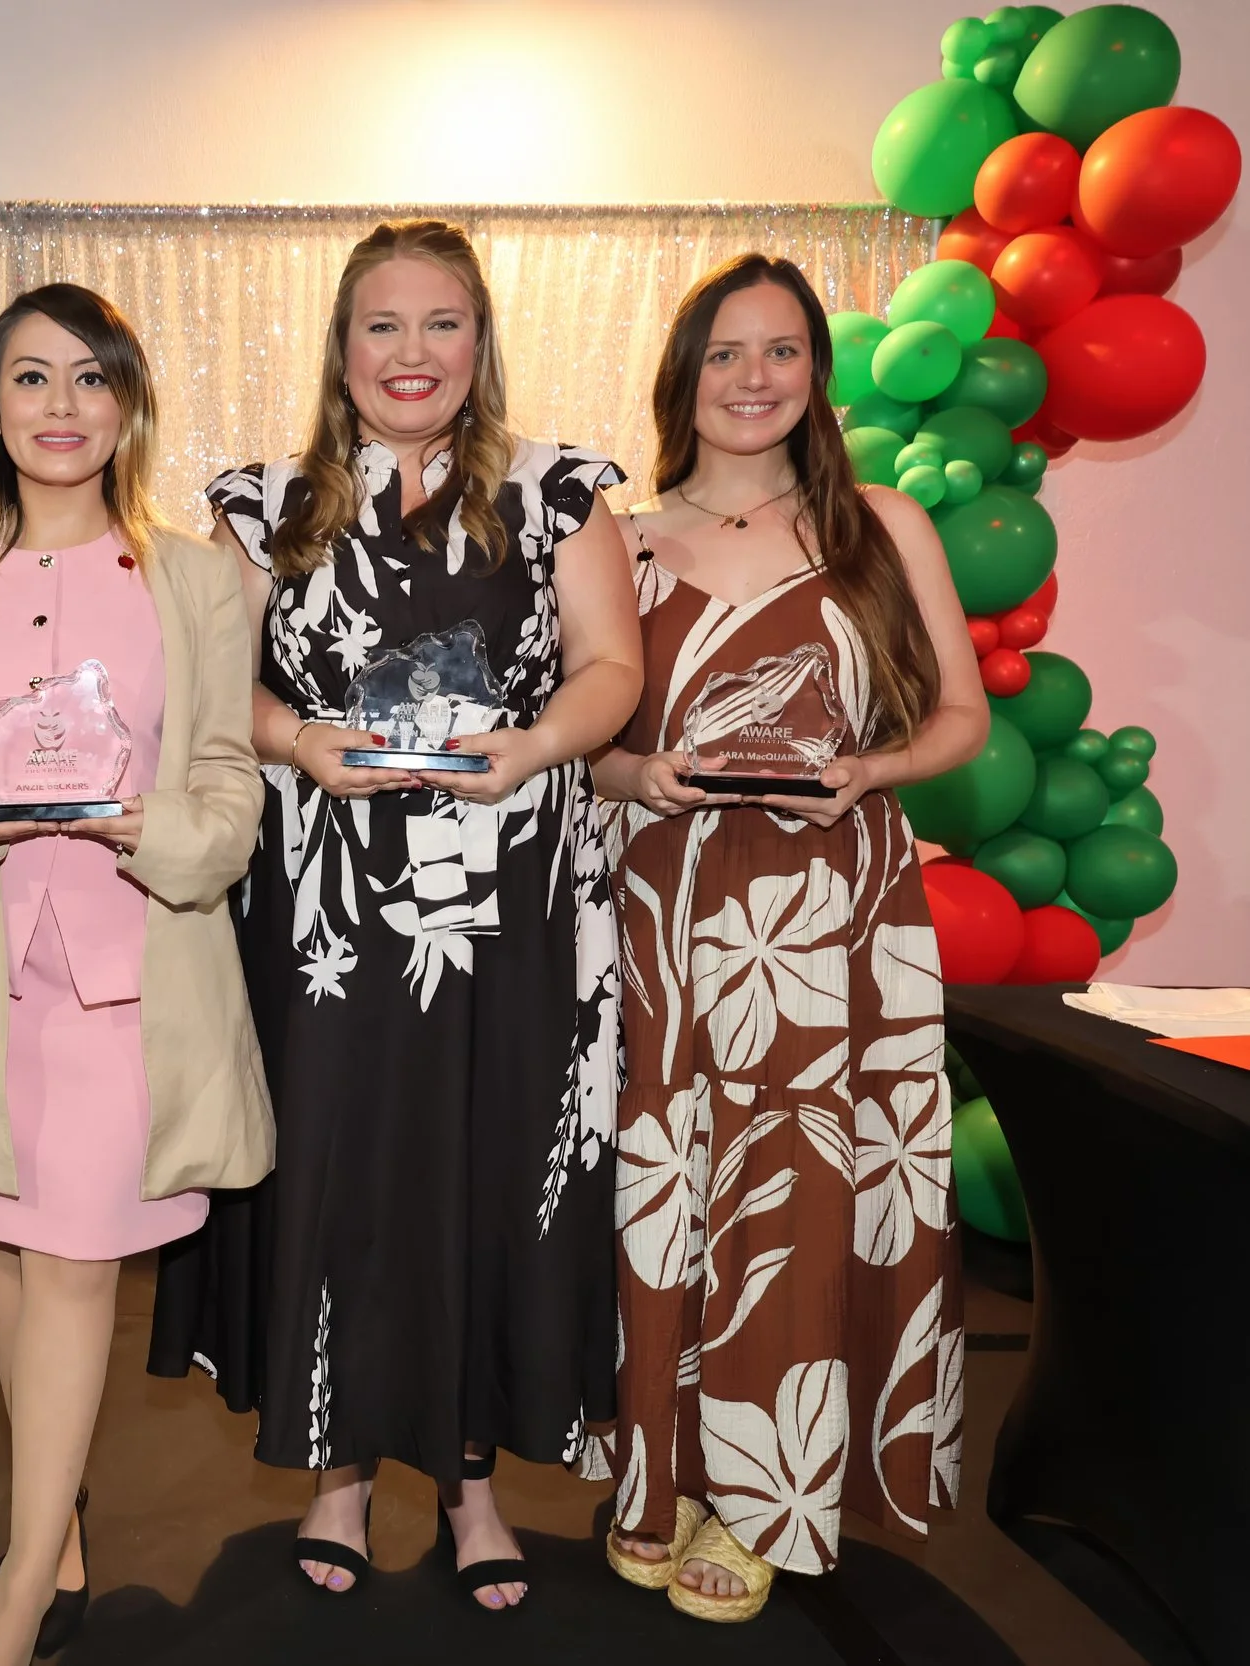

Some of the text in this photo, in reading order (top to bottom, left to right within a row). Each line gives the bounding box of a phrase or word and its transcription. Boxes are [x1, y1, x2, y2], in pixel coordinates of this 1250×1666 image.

[399, 702, 449, 716] AWARE
[739, 726, 793, 738] AWARE
[26, 749, 78, 766] AWARE
[719, 750, 745, 760] SARA
